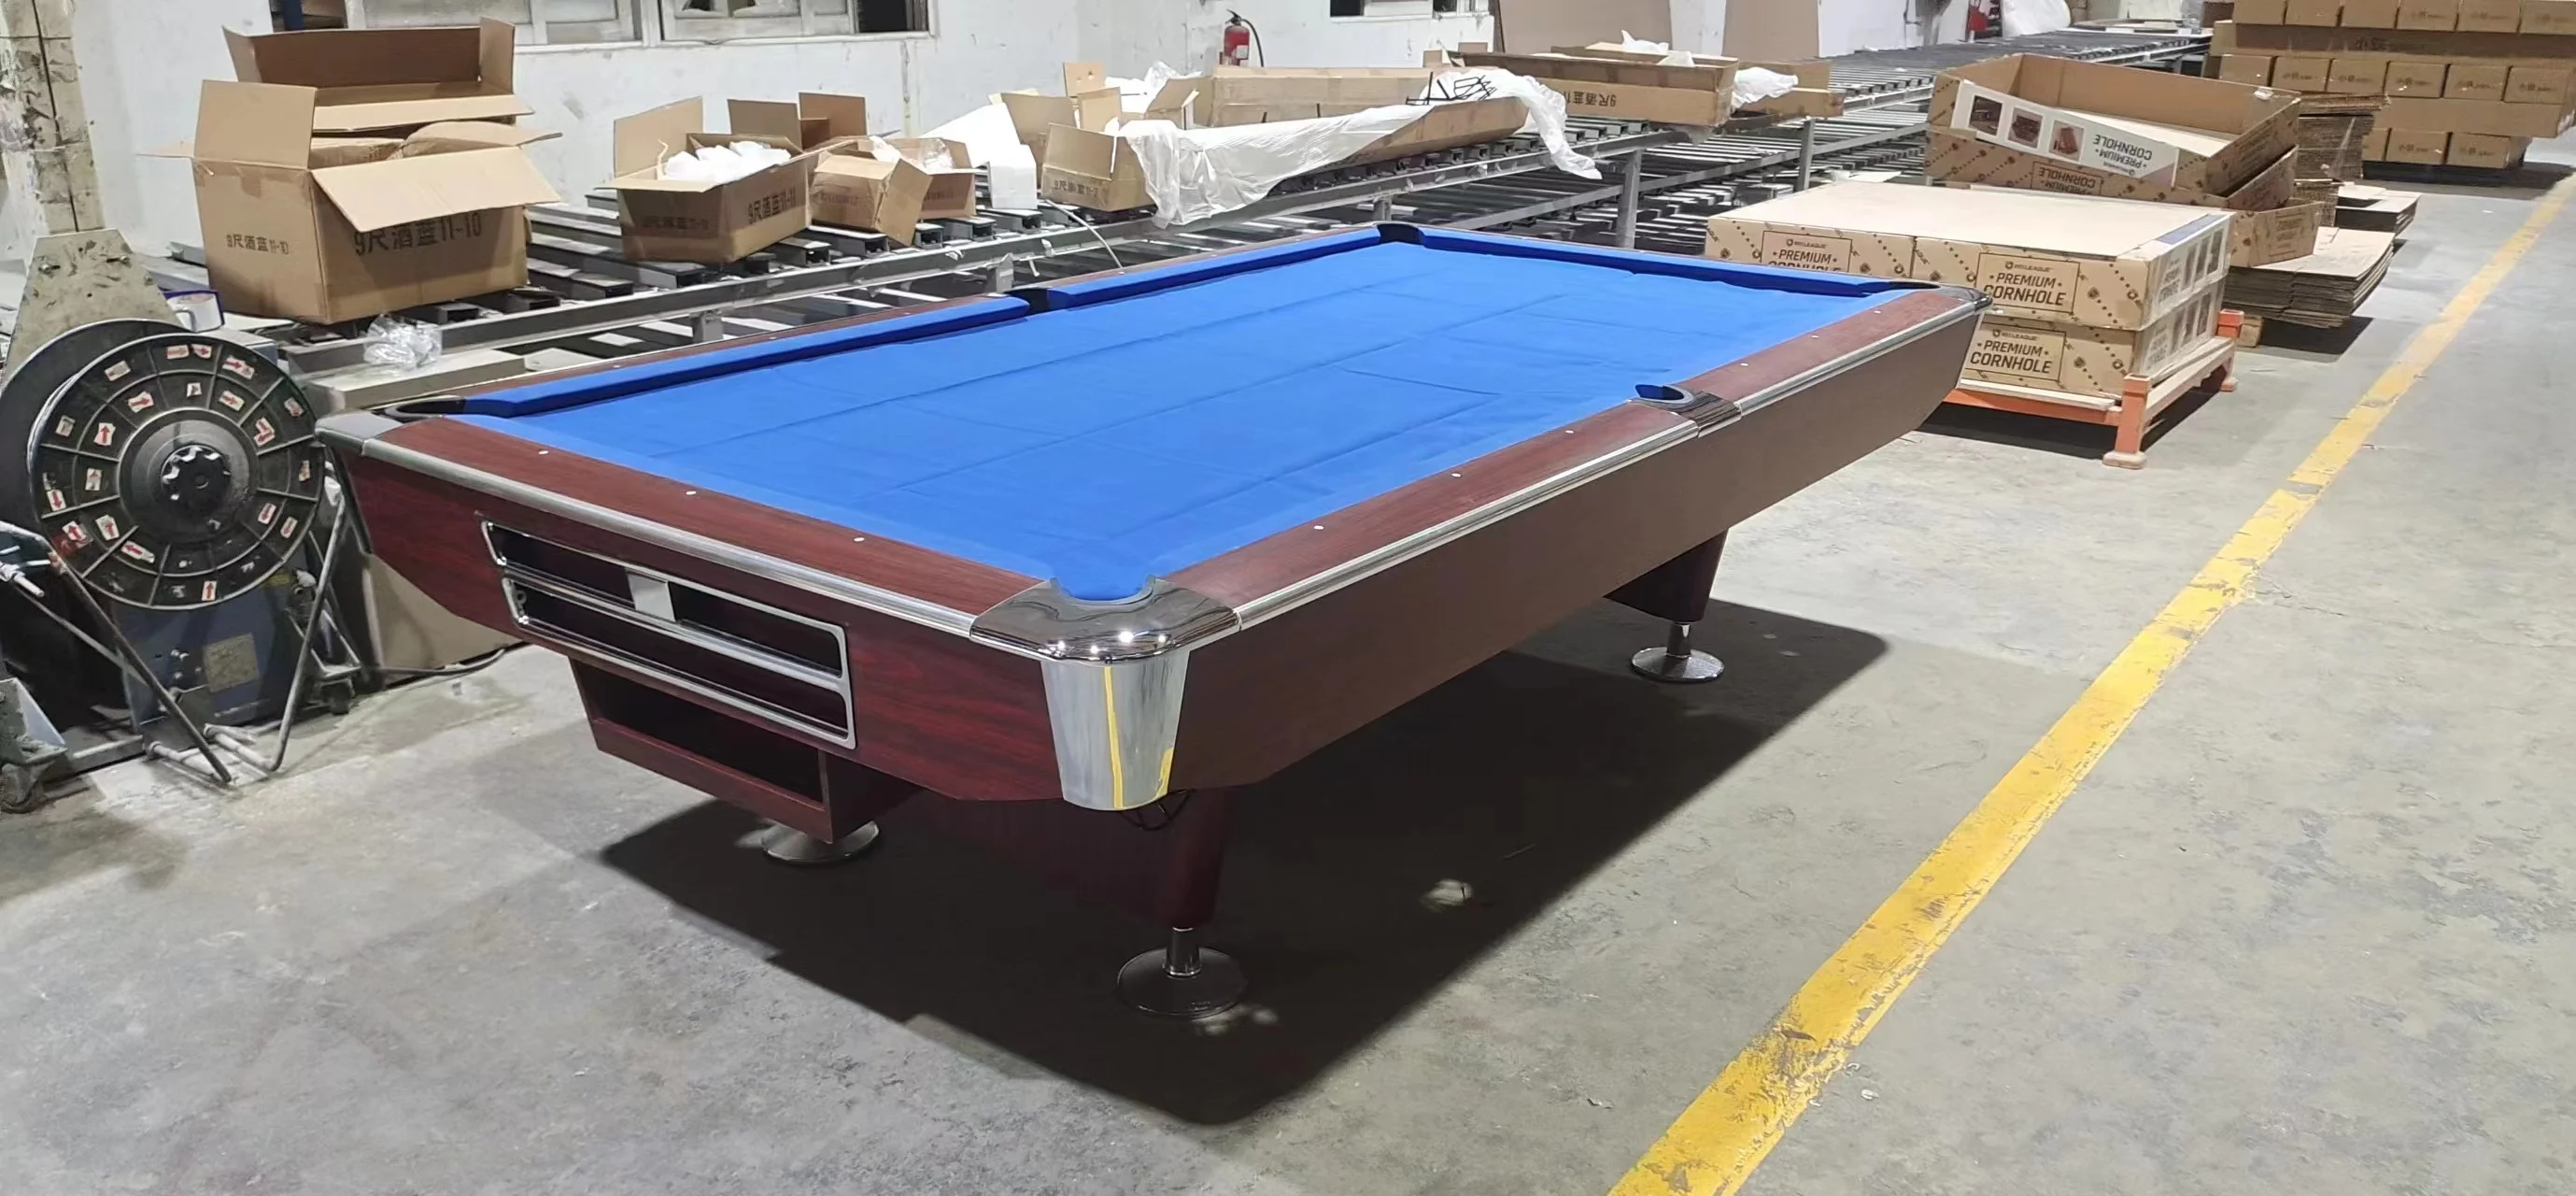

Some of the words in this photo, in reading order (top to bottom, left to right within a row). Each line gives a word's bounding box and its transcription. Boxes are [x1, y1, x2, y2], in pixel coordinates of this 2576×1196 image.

[2092, 134, 2153, 161] CORNHOLE
[2099, 149, 2143, 169] PREMIUM
[2039, 166, 2097, 188] CORNHOLE
[1778, 249, 1832, 264] PREMIUM
[1995, 272, 2057, 289] PREMIUM
[1983, 340, 2044, 357] PREMIUM
[1970, 351, 2053, 374] CORNHOLE
